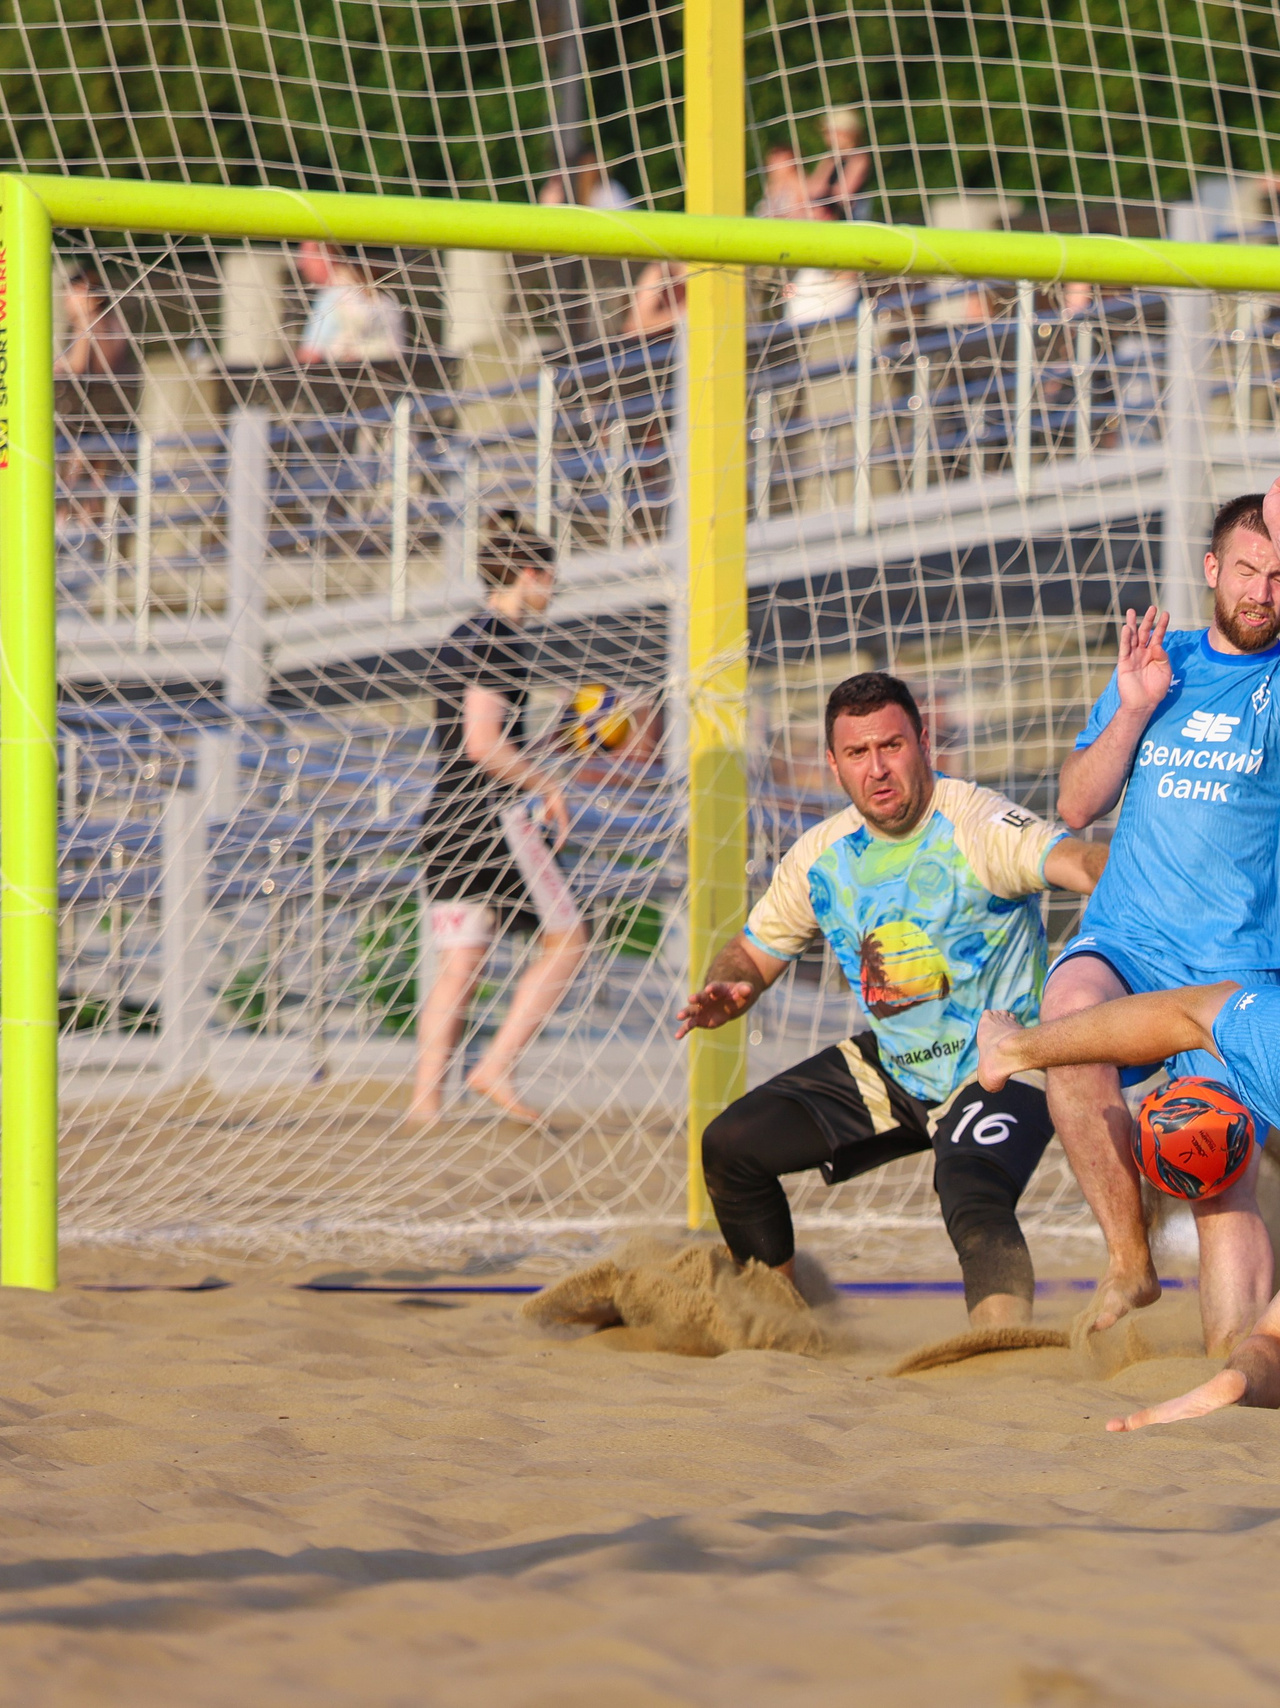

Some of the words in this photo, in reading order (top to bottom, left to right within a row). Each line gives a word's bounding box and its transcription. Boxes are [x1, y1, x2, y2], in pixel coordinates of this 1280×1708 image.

[1139, 740, 1264, 775] Земский
[1157, 771, 1231, 802] банк
[951, 1101, 1018, 1145] 16
